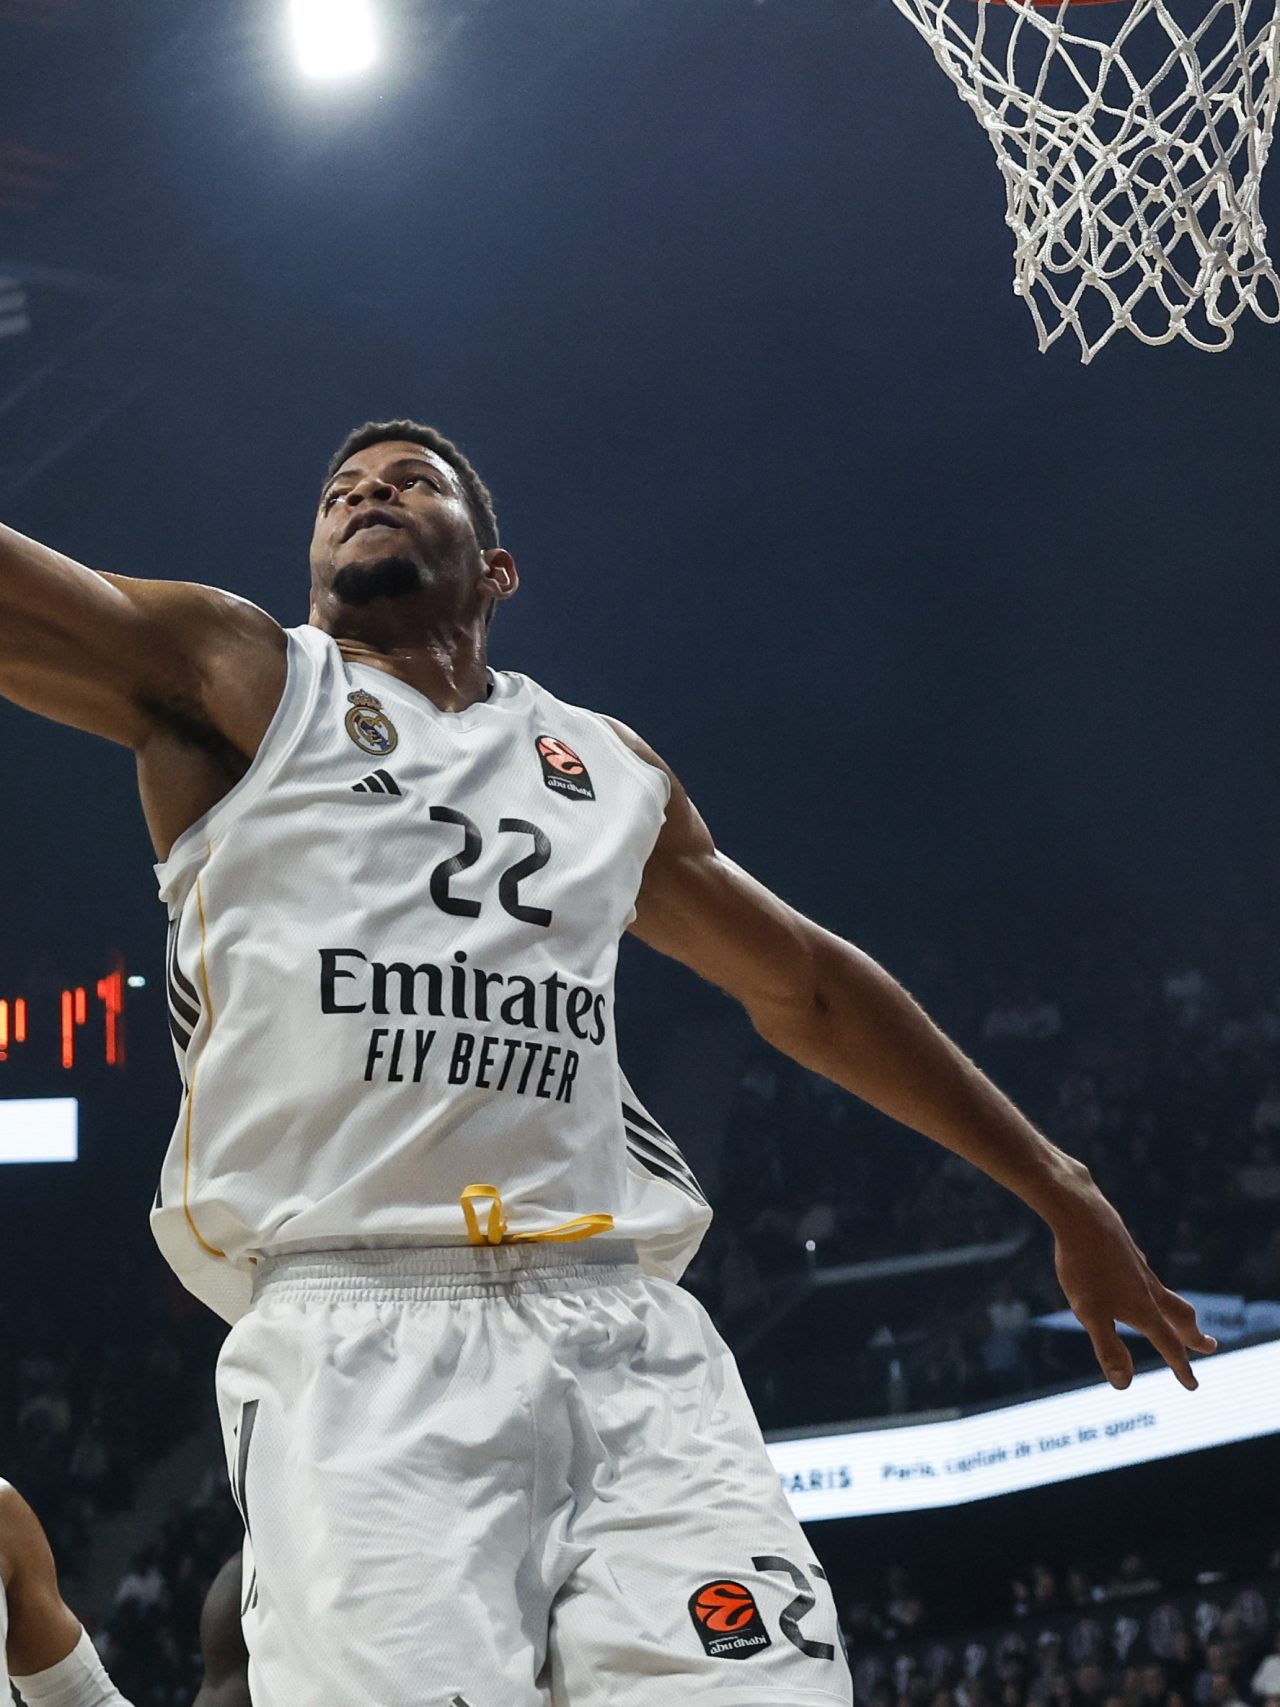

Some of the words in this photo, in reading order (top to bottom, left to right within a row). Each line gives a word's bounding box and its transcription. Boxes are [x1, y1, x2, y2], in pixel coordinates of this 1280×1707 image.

[429, 806, 553, 928] 22
[318, 948, 606, 1046] Emirates
[363, 1028, 437, 1083] FLY
[447, 1032, 580, 1104] BETTER
[710, 1642, 733, 1654] abu
[732, 1635, 767, 1648] dhabi
